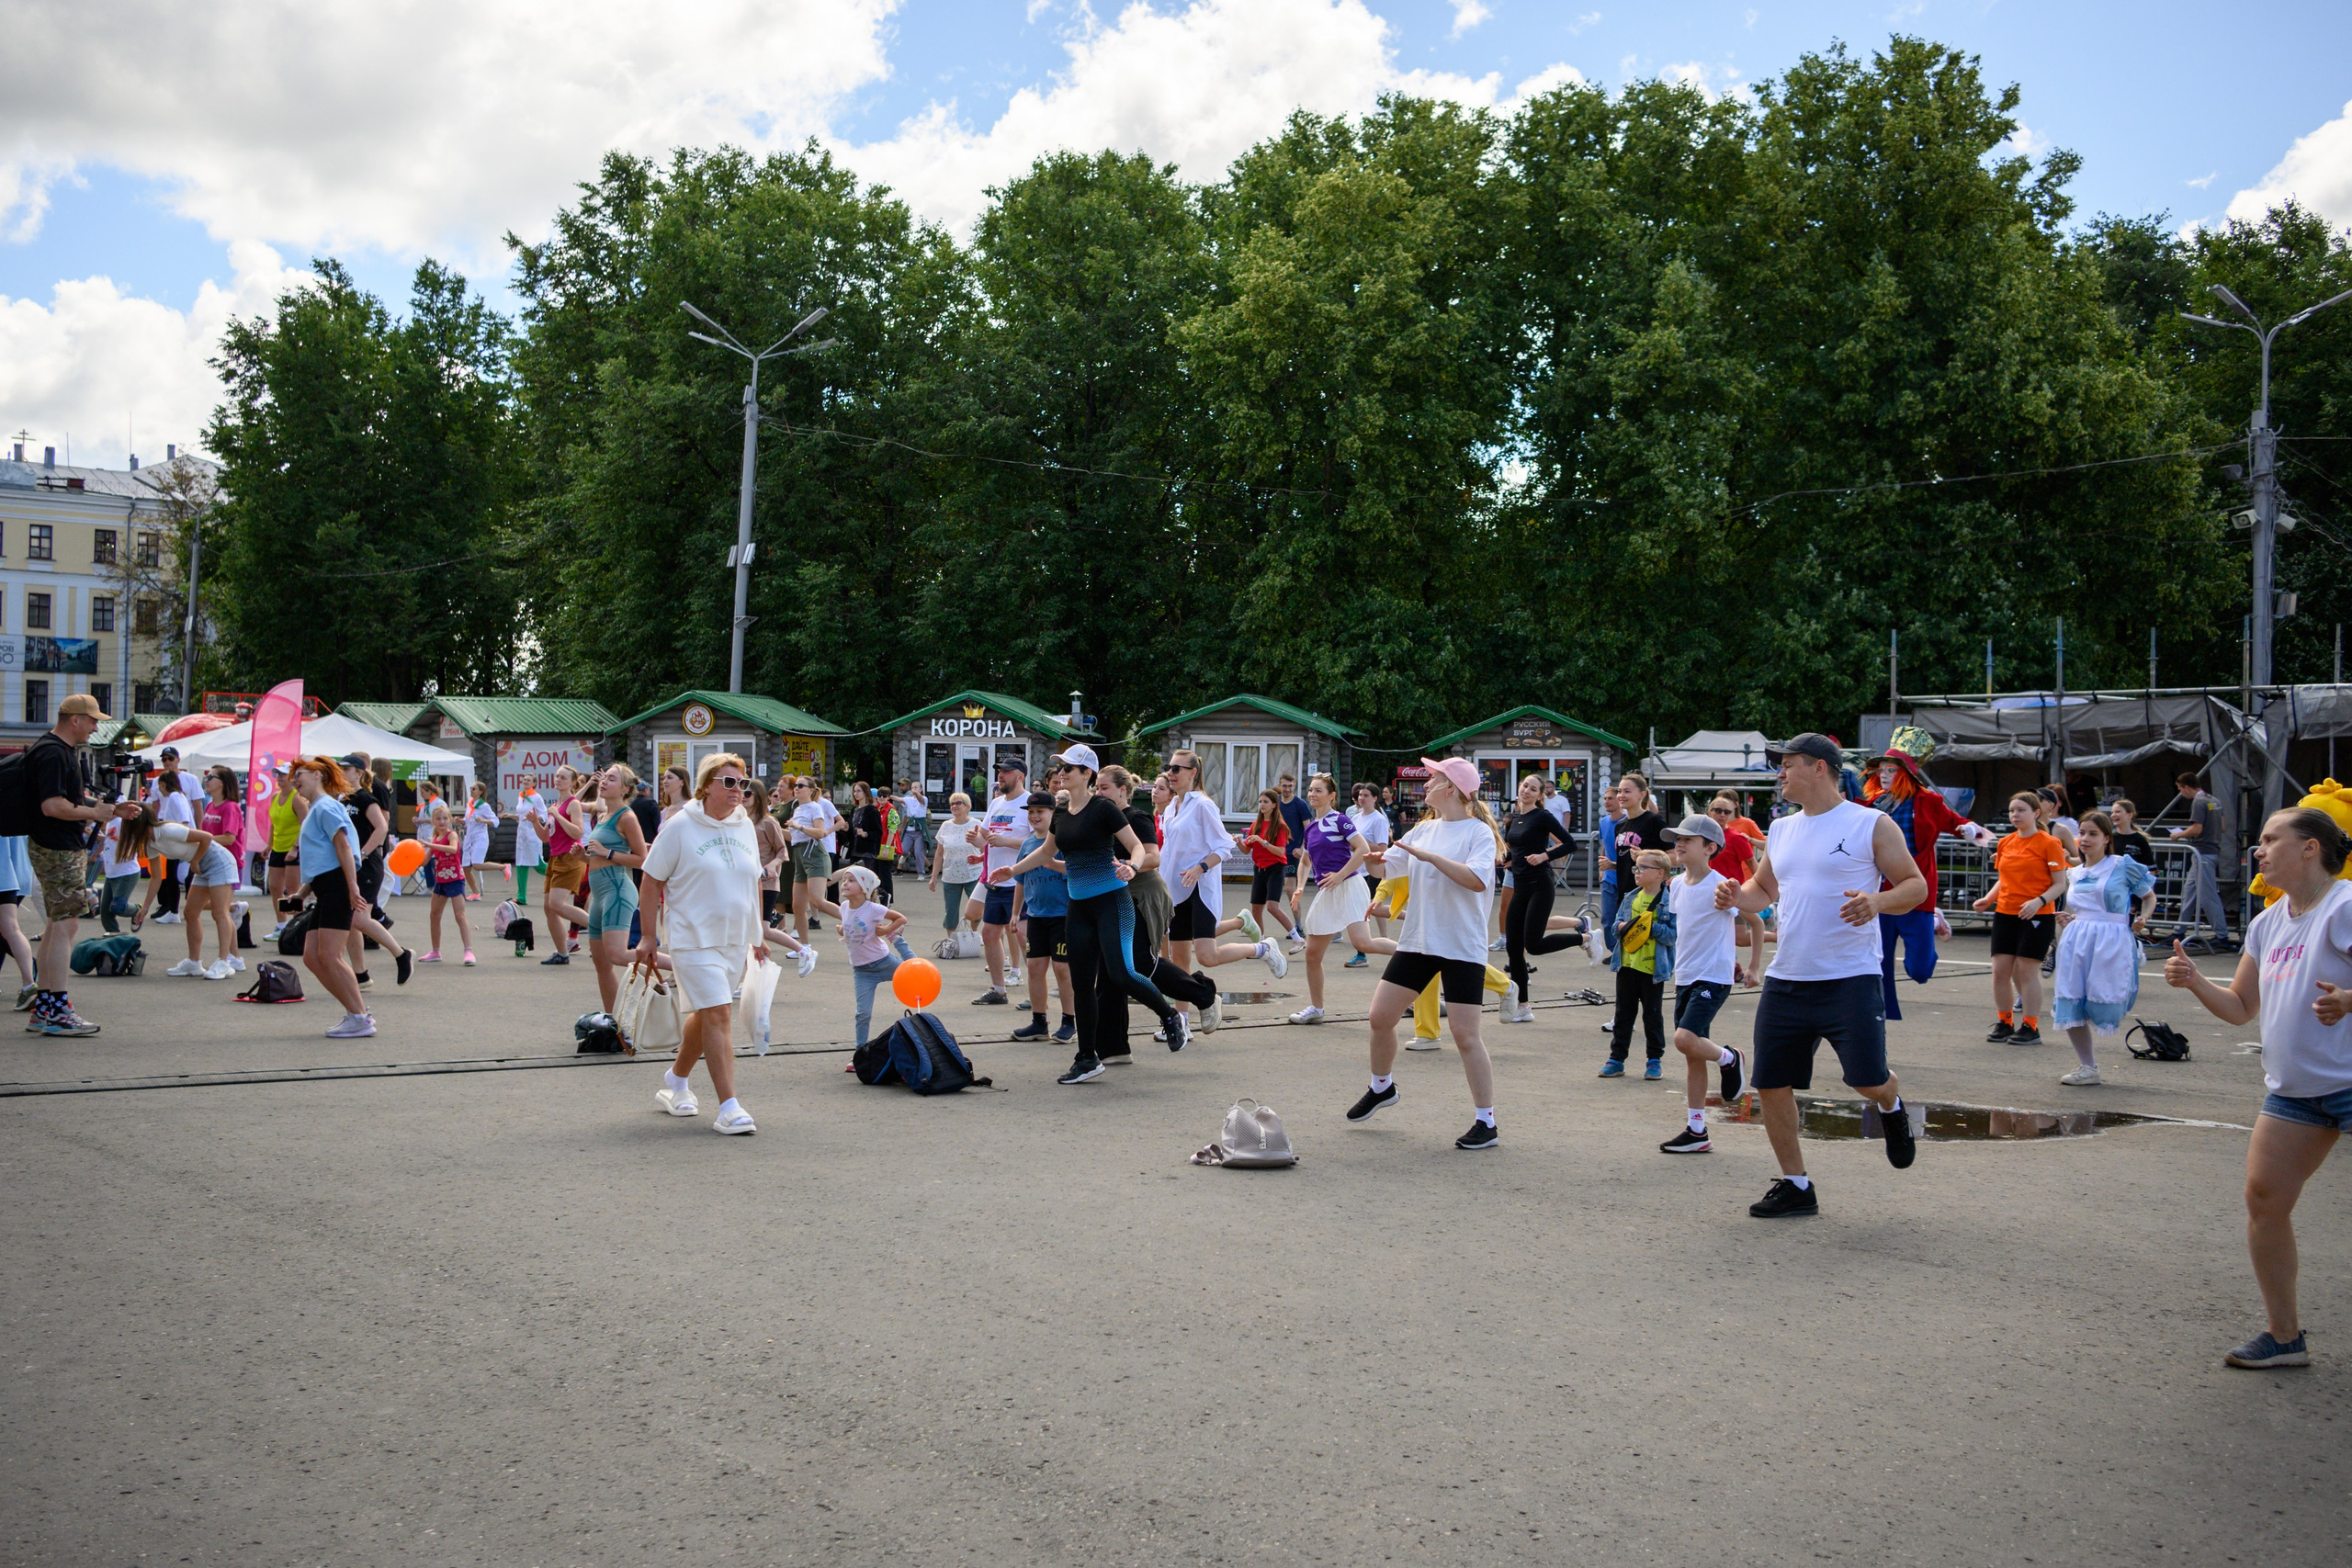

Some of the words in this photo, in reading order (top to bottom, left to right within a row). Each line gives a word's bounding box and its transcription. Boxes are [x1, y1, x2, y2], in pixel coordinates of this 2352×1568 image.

[931, 718, 1016, 738] КОРОНА
[522, 750, 568, 770] ДОМ
[695, 837, 724, 856] LEISURE
